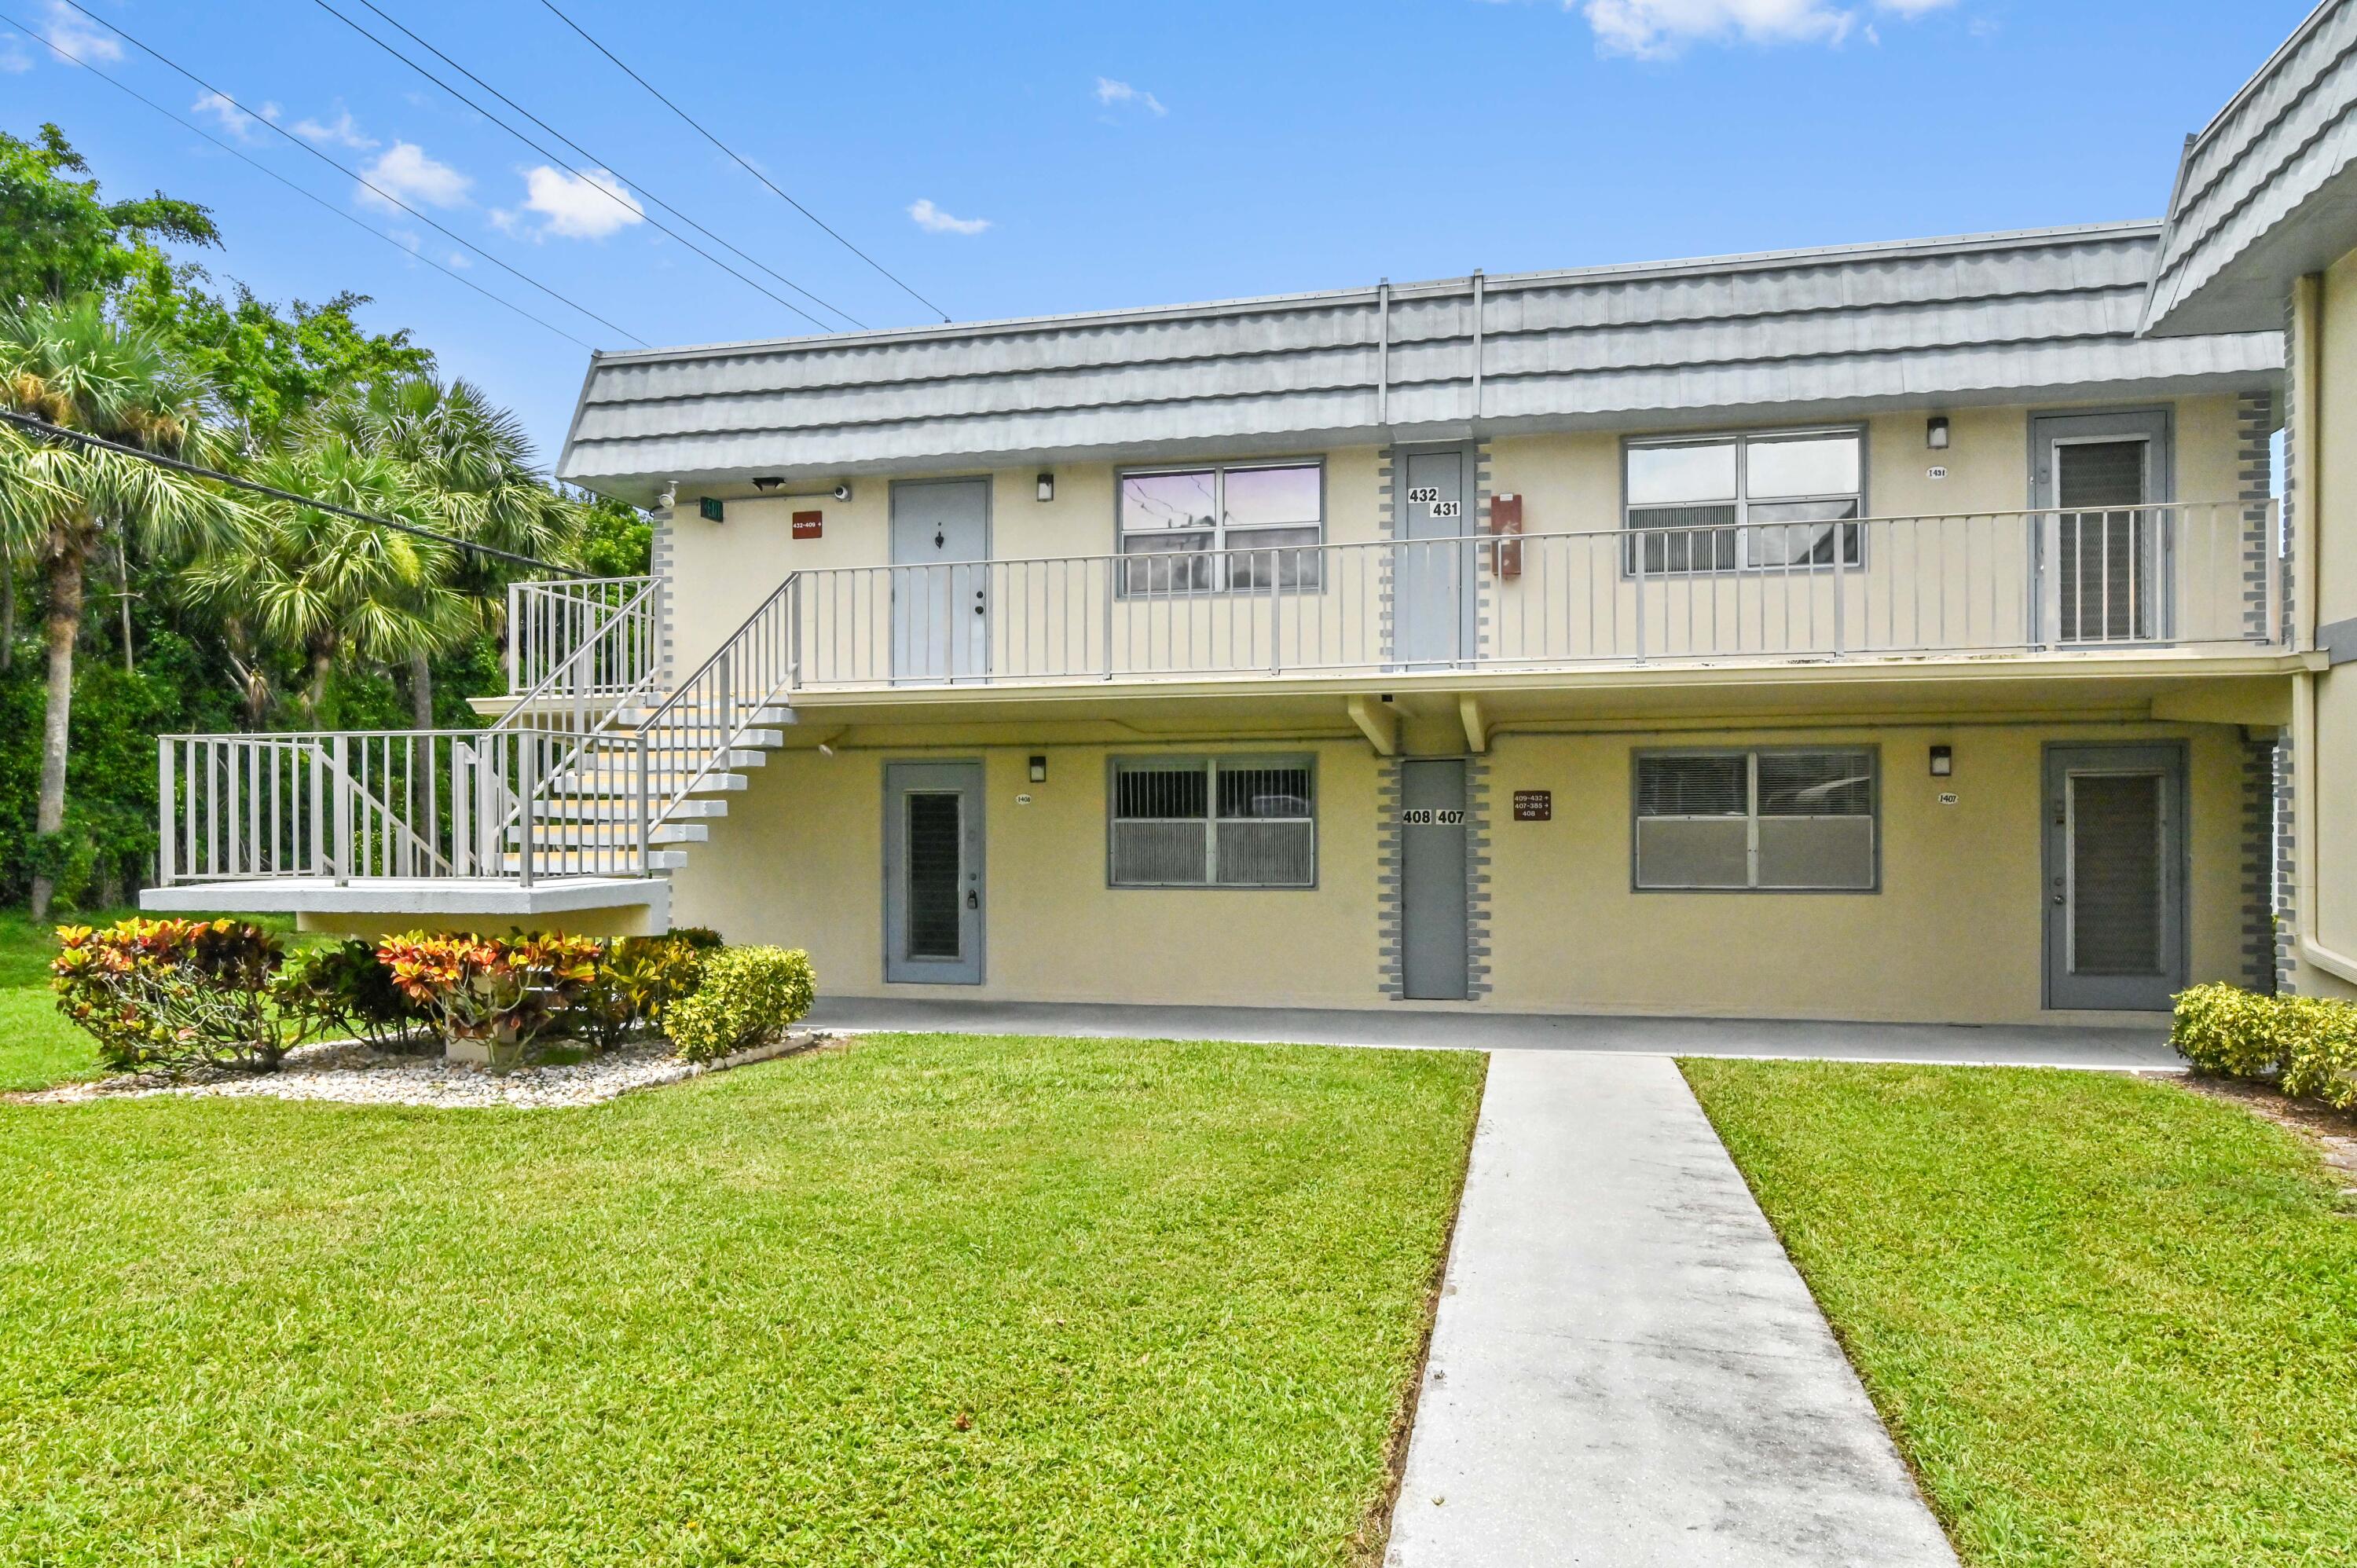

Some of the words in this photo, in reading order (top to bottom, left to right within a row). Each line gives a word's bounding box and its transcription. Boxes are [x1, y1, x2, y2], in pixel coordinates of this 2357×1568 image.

[1409, 489, 1437, 502] 432
[1433, 503, 1457, 515] 431
[1403, 811, 1430, 823] 408
[1438, 811, 1464, 823] 407
